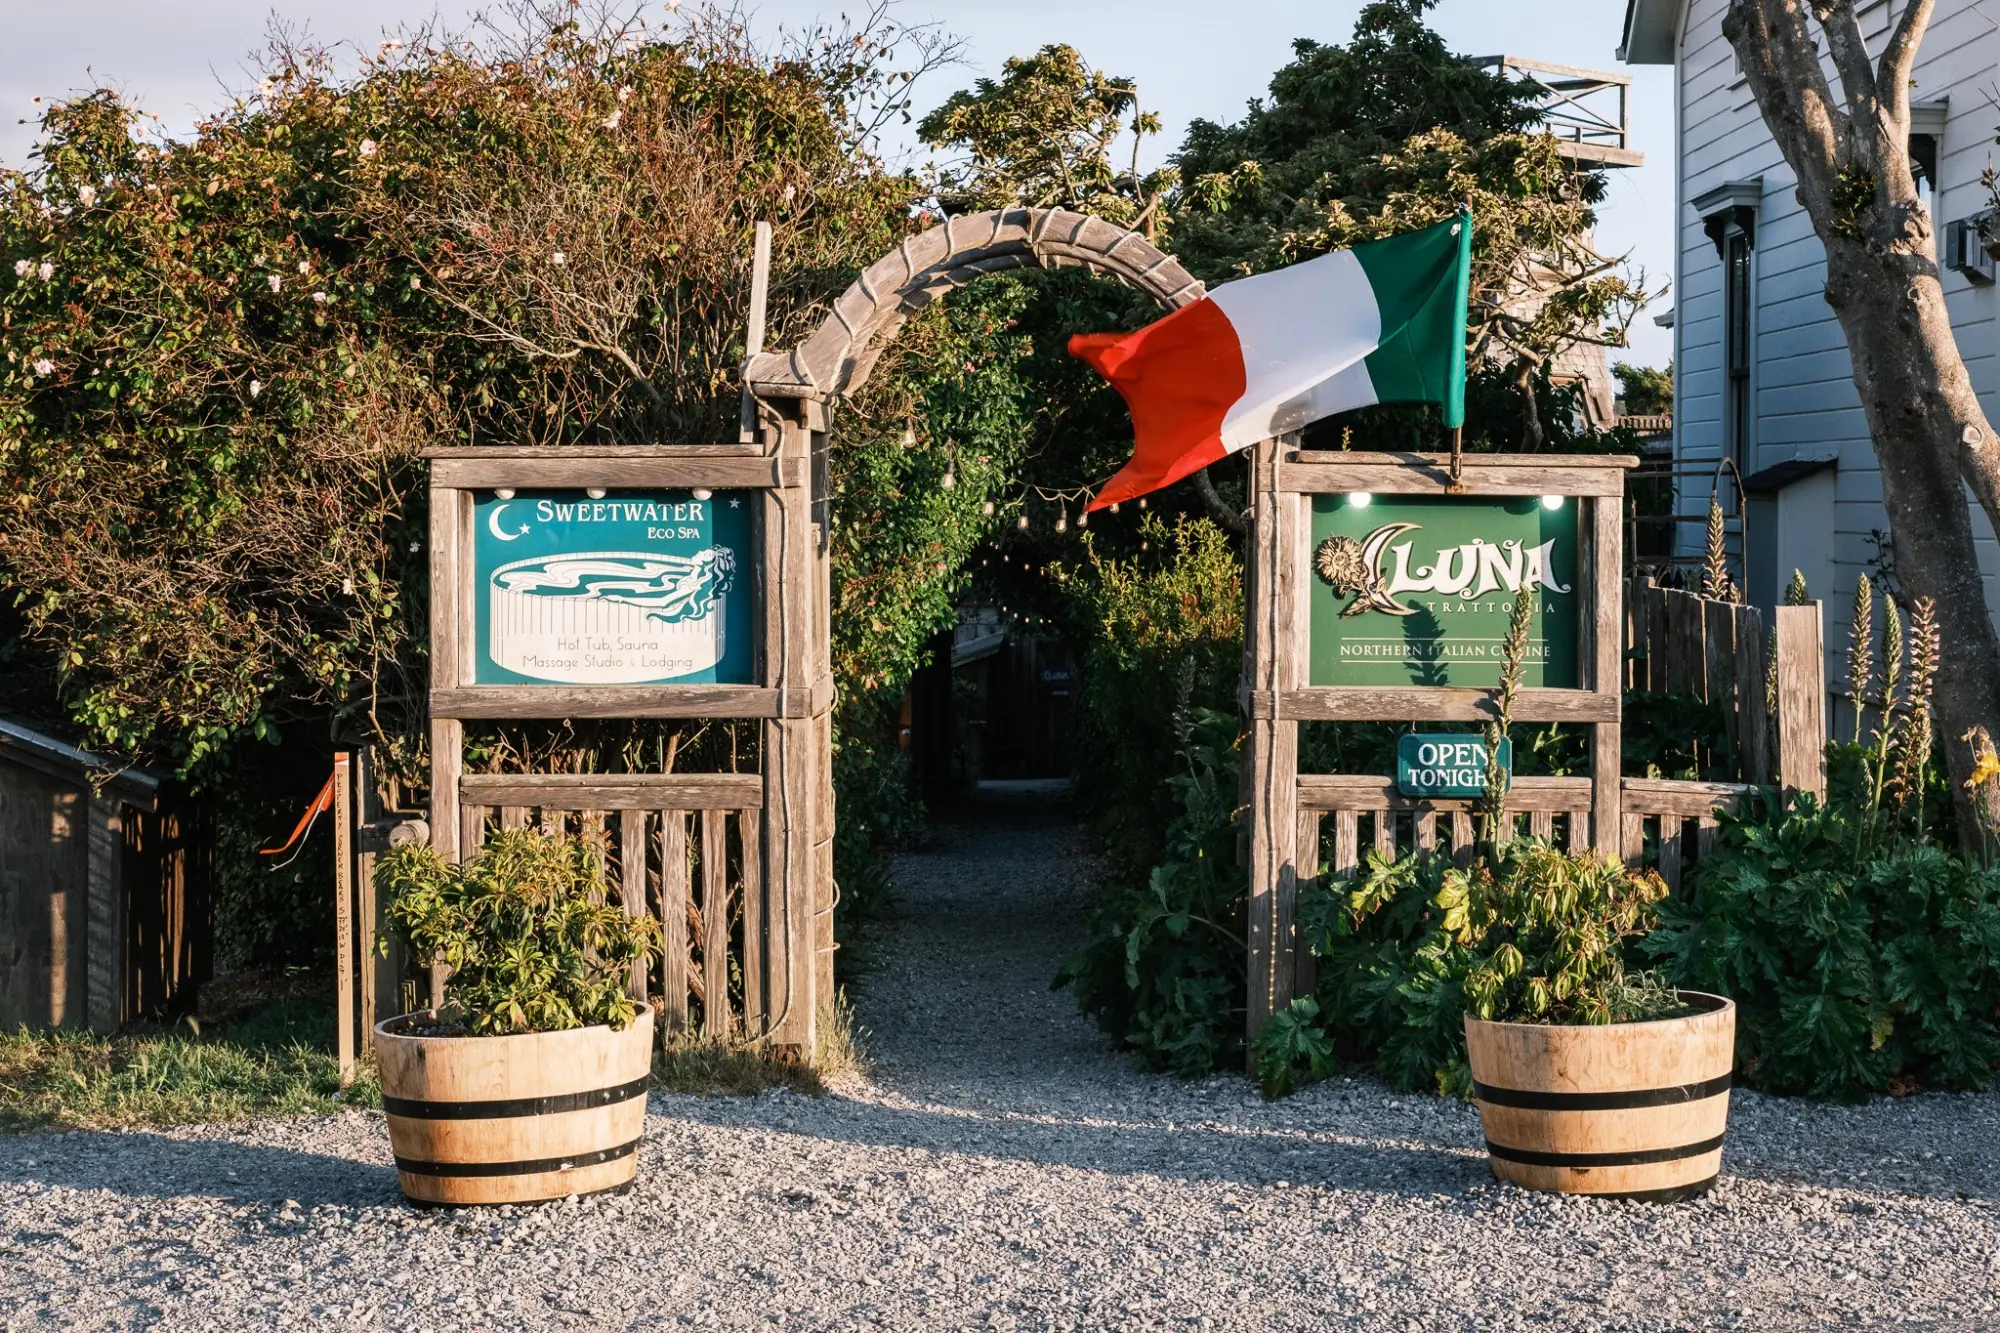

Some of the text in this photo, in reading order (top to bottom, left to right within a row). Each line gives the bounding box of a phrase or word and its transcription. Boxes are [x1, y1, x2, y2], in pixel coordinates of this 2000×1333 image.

[1387, 538, 1572, 600] LUNA
[1427, 602, 1555, 613] TRATTOIA
[557, 637, 658, 652] Hot Tub, Sauna
[1340, 644, 1551, 657] NORTHERN ITALIAN CUINE
[522, 655, 579, 671] Massage
[584, 654, 623, 668] Studio
[641, 655, 693, 671] Lodging
[1418, 743, 1490, 766] OPEN
[1408, 768, 1490, 787] TONIGH
